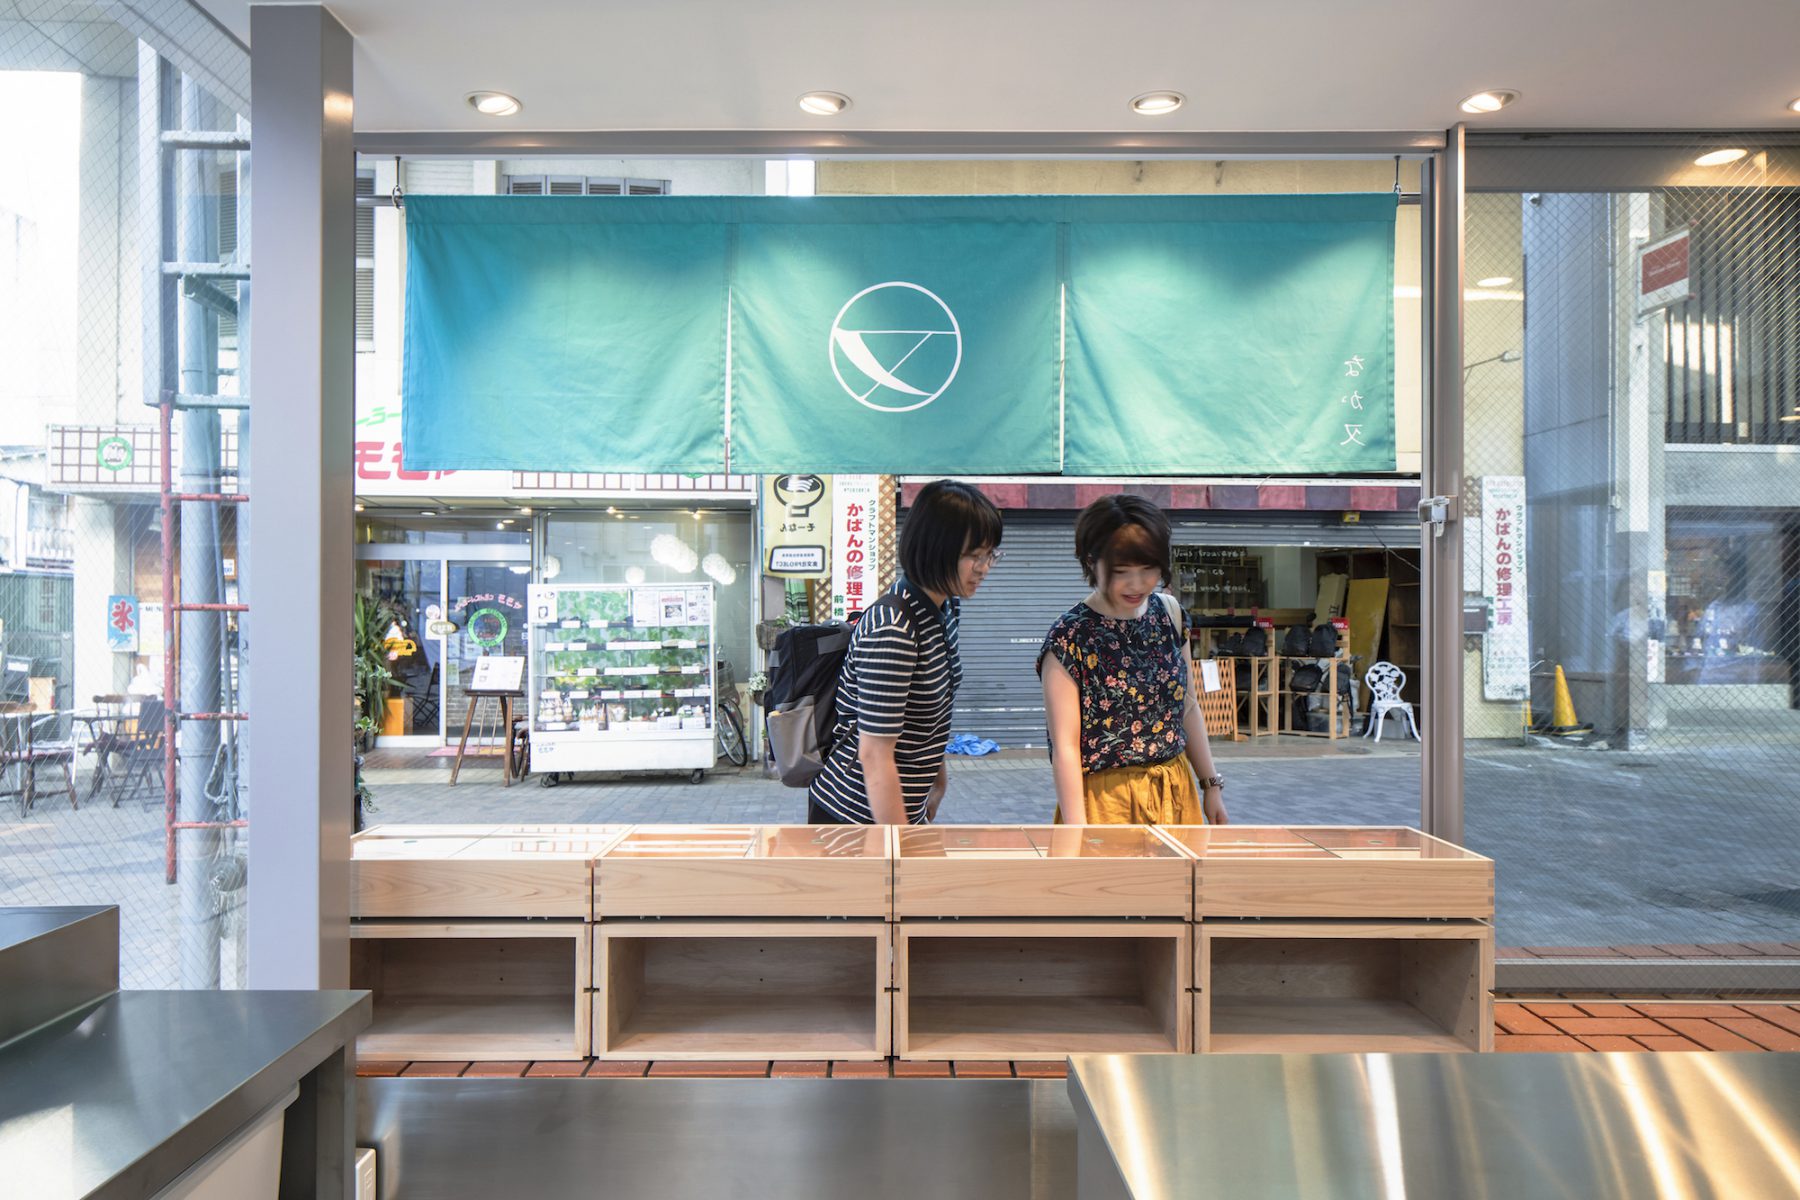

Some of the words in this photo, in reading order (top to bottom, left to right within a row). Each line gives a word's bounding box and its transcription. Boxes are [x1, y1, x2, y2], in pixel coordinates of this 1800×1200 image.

[111, 599, 135, 632] 氷
[846, 503, 864, 625] かばんの修理工
[1495, 508, 1513, 626] かばんの修理工房
